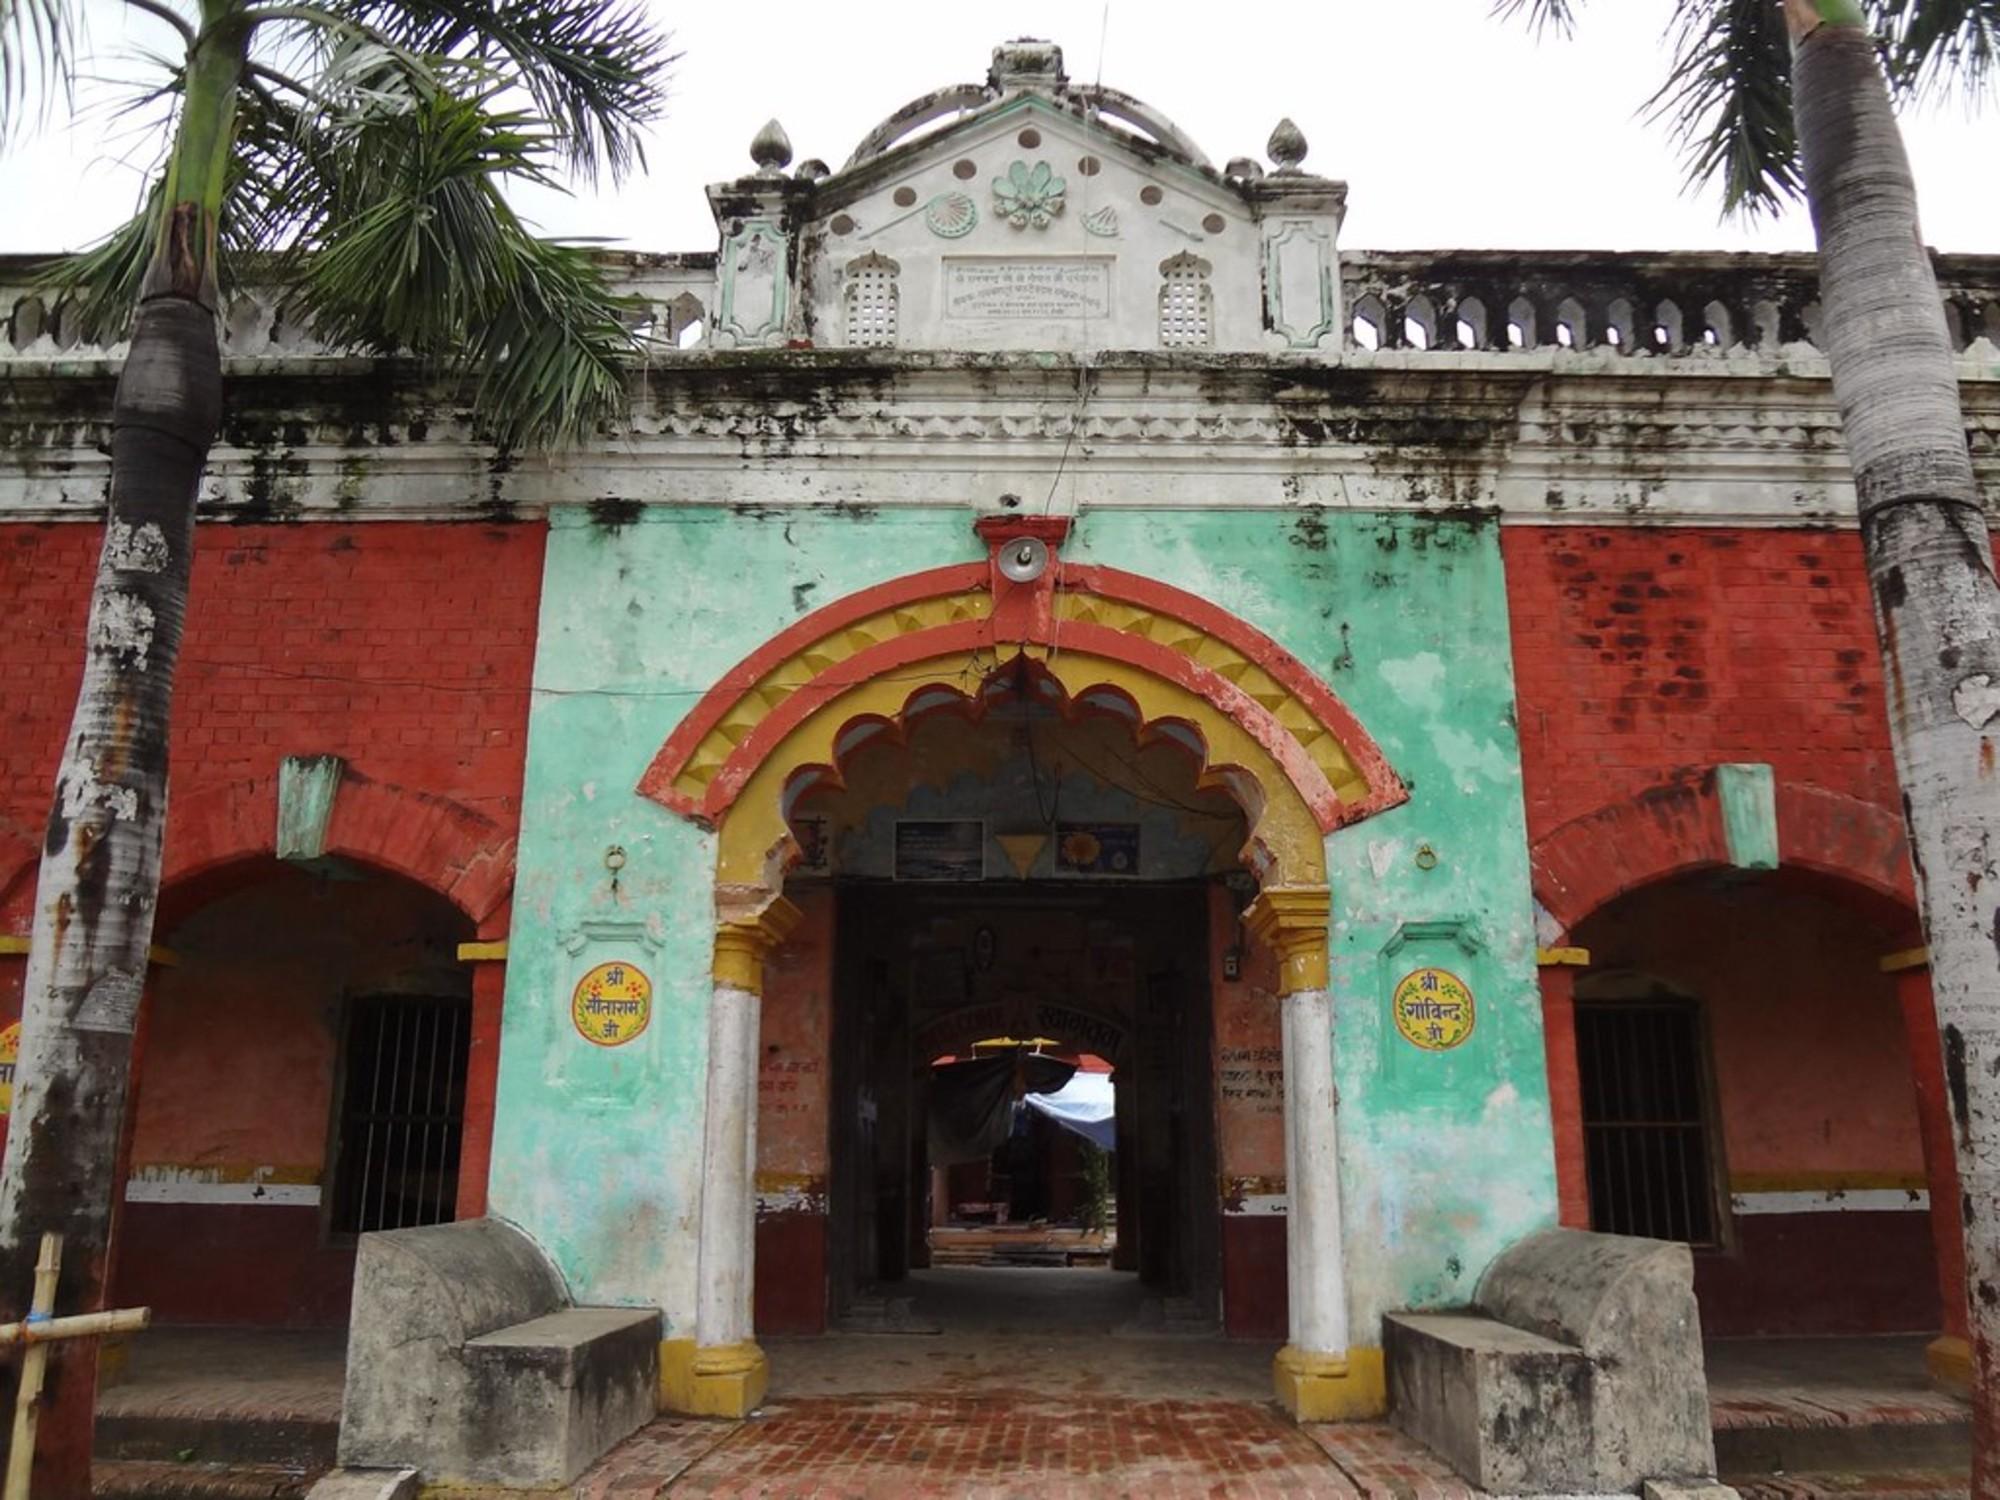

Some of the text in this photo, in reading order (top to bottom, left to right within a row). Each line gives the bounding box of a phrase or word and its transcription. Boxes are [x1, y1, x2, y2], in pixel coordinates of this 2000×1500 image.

[606, 966, 624, 986] श्री
[1420, 971, 1438, 992] श्री
[1405, 996, 1462, 1021] गोविन्द
[601, 1019, 621, 1038] जी
[1425, 1021, 1445, 1042] जी
